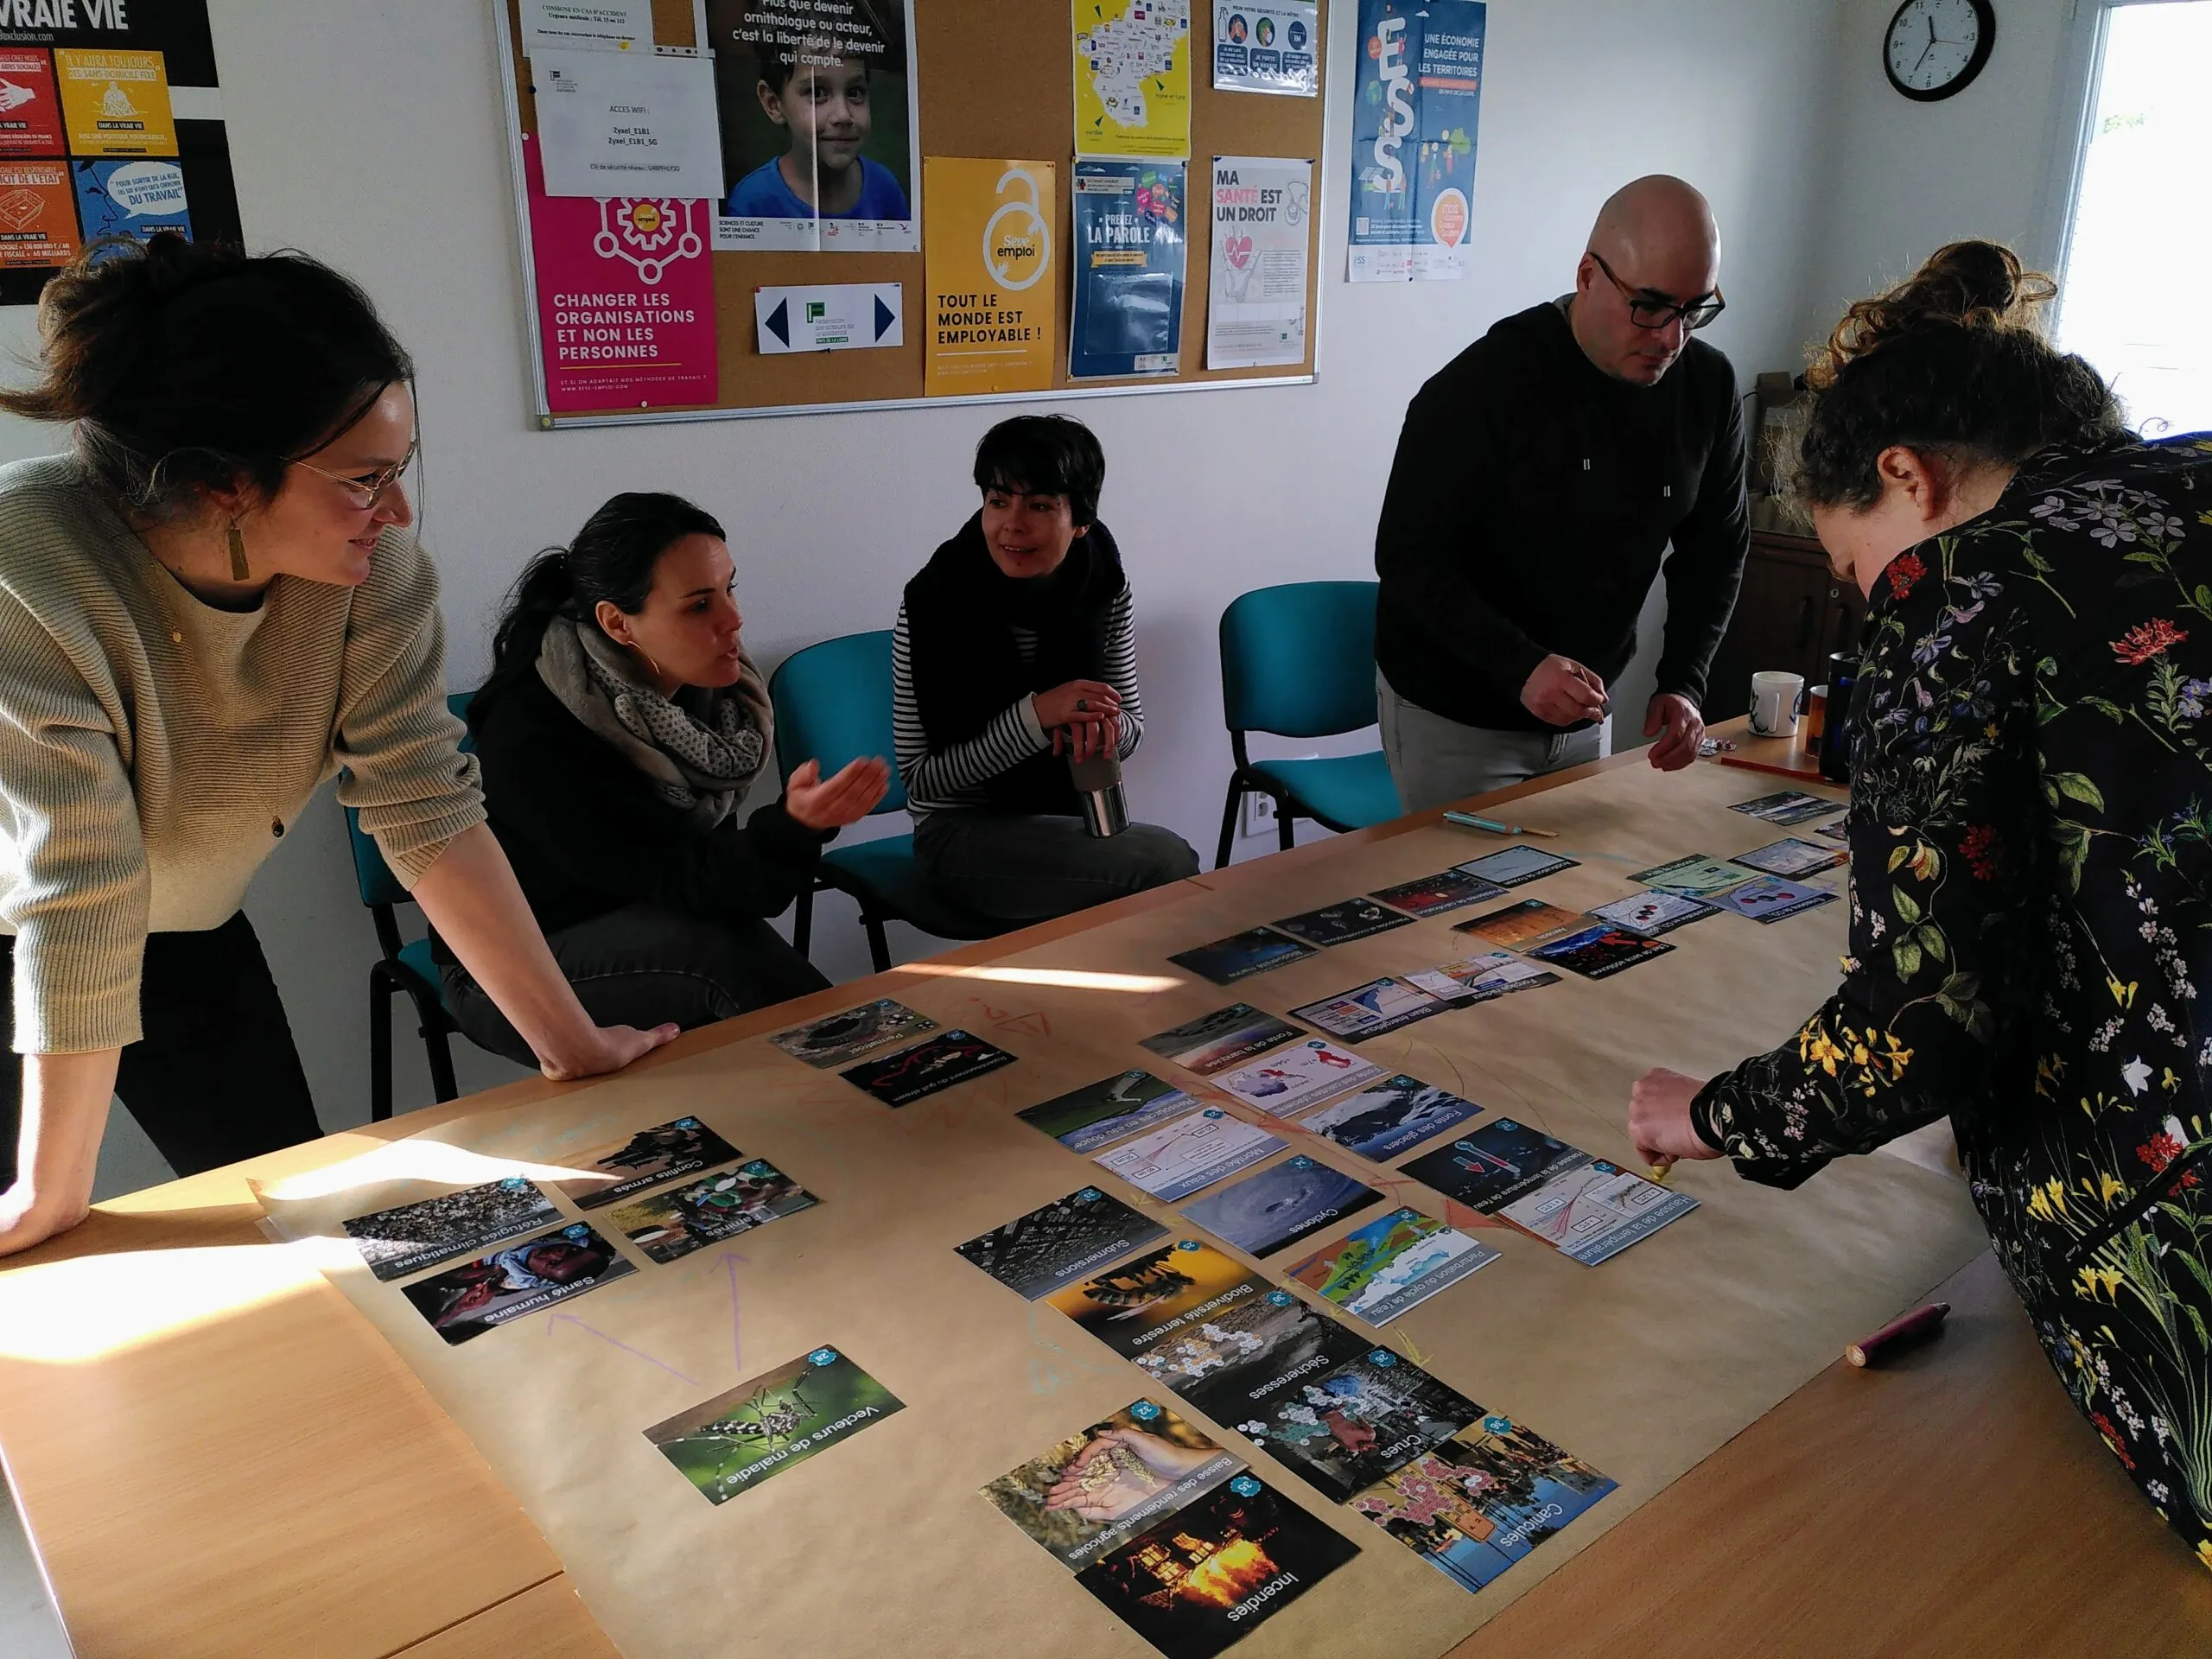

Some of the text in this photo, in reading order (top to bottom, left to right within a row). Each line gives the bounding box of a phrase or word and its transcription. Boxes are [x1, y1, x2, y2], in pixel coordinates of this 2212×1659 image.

[0, 0, 130, 30] VRAIE VIE
[788, 0, 855, 16] que devenir
[1967, 10, 1973, 18] 2
[744, 12, 873, 37] ornithologue ou acteur,
[733, 28, 886, 54] c'est la liberté de le devenir
[1425, 32, 1480, 48] UNE ÉCONOMIE
[1970, 32, 1975, 41] 3
[75, 55, 83, 67] Y
[84, 55, 107, 67] AURA
[779, 51, 844, 69] qui compte.
[1424, 48, 1478, 62] ENGAGÉE POUR
[1418, 63, 1478, 77] LES TERRITOIRES
[1896, 60, 1901, 69] 8
[1908, 75, 1913, 84] 7
[613, 127, 650, 136] Zyxel_E1B1
[18, 175, 29, 183] DE
[1217, 171, 1239, 185] MA
[128, 194, 143, 205] DU
[1217, 185, 1282, 204] SANTÉ EST
[1217, 207, 1277, 221] UN DROIT
[1088, 226, 1150, 244] LA PAROLE
[997, 244, 1035, 260] emploi
[554, 293, 671, 308] CHANGER LES
[938, 294, 997, 308] TOUT LE
[556, 309, 695, 325] ORGANISATIONS
[938, 311, 1024, 327] MONDE EST
[557, 327, 654, 343] ET NON LES
[938, 327, 1031, 344] EMPLOYABLE
[559, 345, 658, 360] PERSONNES
[1409, 1005, 1432, 1017] Bilan
[848, 1033, 904, 1054] Permafrost
[1266, 1031, 1294, 1044] Fonte
[1205, 1049, 1247, 1068] banquise
[1106, 1125, 1125, 1136] eau
[1125, 1118, 1139, 1128] en
[1382, 1109, 1463, 1151] Fonte des glaciers
[1073, 1131, 1106, 1149] douce
[1557, 1151, 1584, 1166] Hausse
[1178, 1147, 1266, 1189] Montée des eaux
[1541, 1167, 1549, 1176] la
[1548, 1164, 1559, 1173] de
[613, 1160, 703, 1194] Conflits armés
[1501, 1173, 1543, 1196] température
[1473, 1198, 1494, 1209] l'eau
[1655, 1196, 1692, 1217] Hausse
[1288, 1207, 1338, 1234] Cyclones
[1401, 1211, 1413, 1220] 20
[1642, 1215, 1656, 1225] de
[706, 1213, 761, 1236] Famines
[394, 1217, 543, 1270] Réfugiés climatiques
[1576, 1227, 1637, 1261] température
[1055, 1239, 1130, 1279] Submersions
[1371, 1249, 1485, 1317] Perturbation du cycle de l'eau
[484, 1276, 595, 1323] Santé humaine
[1273, 1294, 1285, 1304] 30
[1132, 1284, 1254, 1346] Biodiversité terrestre
[816, 1351, 829, 1362] 28
[1376, 1354, 1389, 1364] 26
[1249, 1354, 1330, 1400] Sécheresses
[1137, 1405, 1153, 1415] 32
[1490, 1418, 1503, 1430] 36
[727, 1405, 880, 1484] Vecteurs de maladie
[1379, 1433, 1422, 1460] Crues
[1237, 1479, 1253, 1492] 35
[1068, 1457, 1234, 1561] Baisse des rendements agricoles
[1498, 1503, 1563, 1548] Canicules
[1226, 1571, 1300, 1624] Incendies
